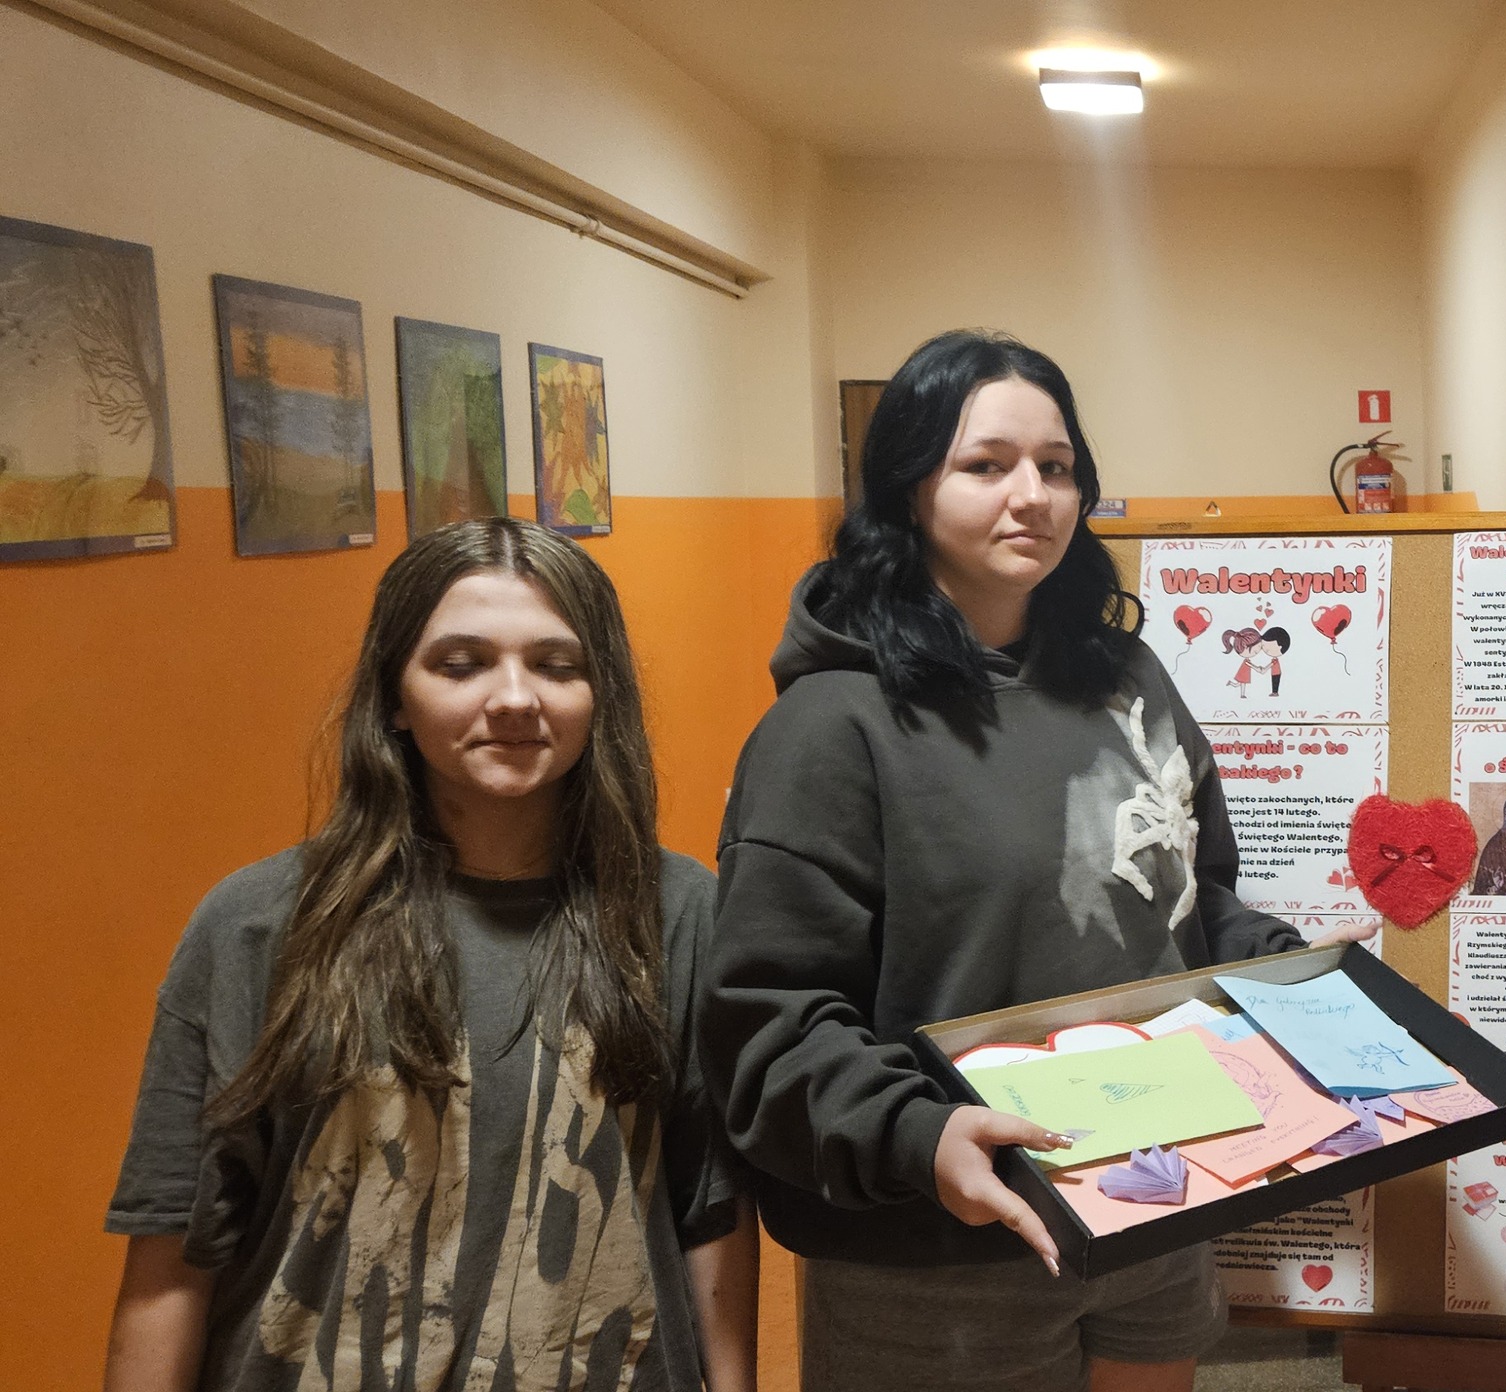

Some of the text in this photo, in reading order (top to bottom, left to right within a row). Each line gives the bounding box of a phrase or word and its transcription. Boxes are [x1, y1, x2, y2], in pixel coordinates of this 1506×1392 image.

[1160, 566, 1366, 604] Walentynki
[1212, 740, 1284, 760] entynki
[1298, 743, 1322, 755] co
[1324, 741, 1348, 755] to
[1218, 764, 1304, 783] takiego ?
[1484, 763, 1496, 773] o
[1250, 808, 1272, 818] jest
[1280, 1240, 1360, 1250] Walentego, która
